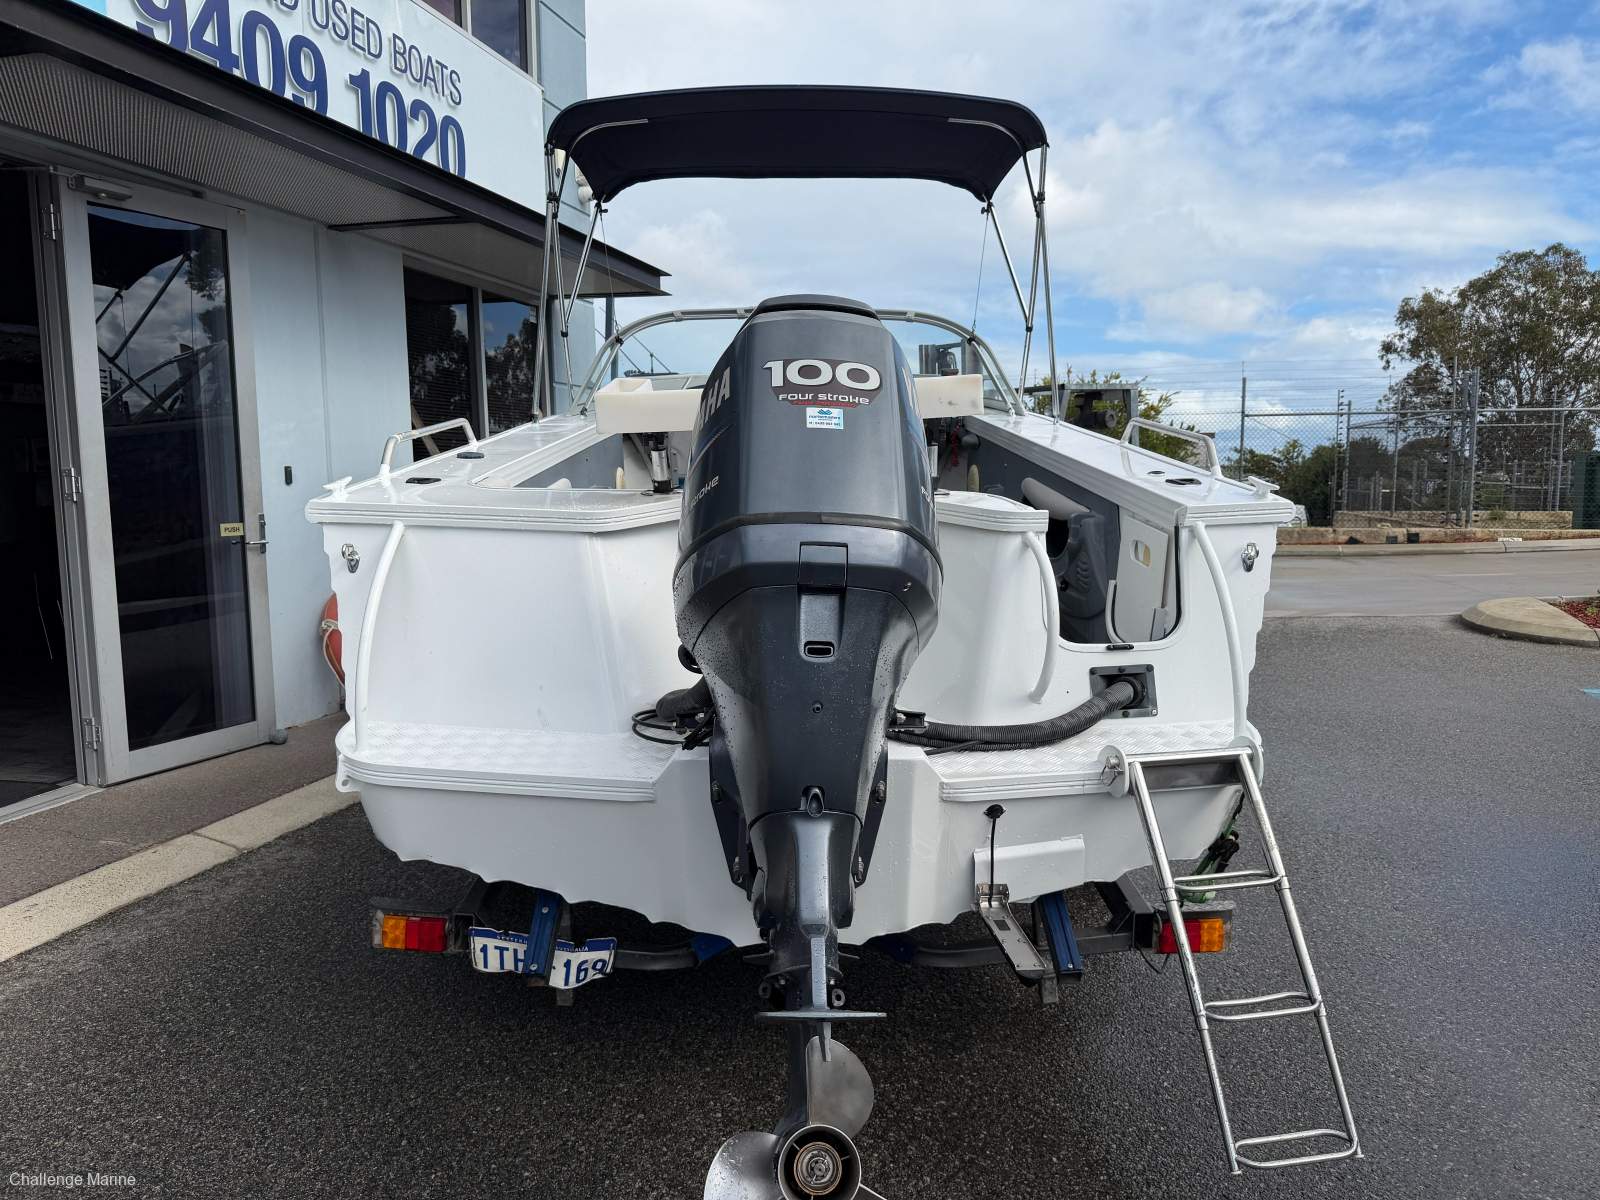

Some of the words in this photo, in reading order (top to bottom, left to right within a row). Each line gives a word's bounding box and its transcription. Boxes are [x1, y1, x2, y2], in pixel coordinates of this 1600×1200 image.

[135, 0, 328, 117] 9409
[349, 68, 466, 179] 1020
[311, 0, 383, 59] USED
[393, 33, 462, 106] BOATS
[763, 359, 881, 391] 100
[480, 943, 529, 971] 1TH
[563, 958, 608, 986] 169
